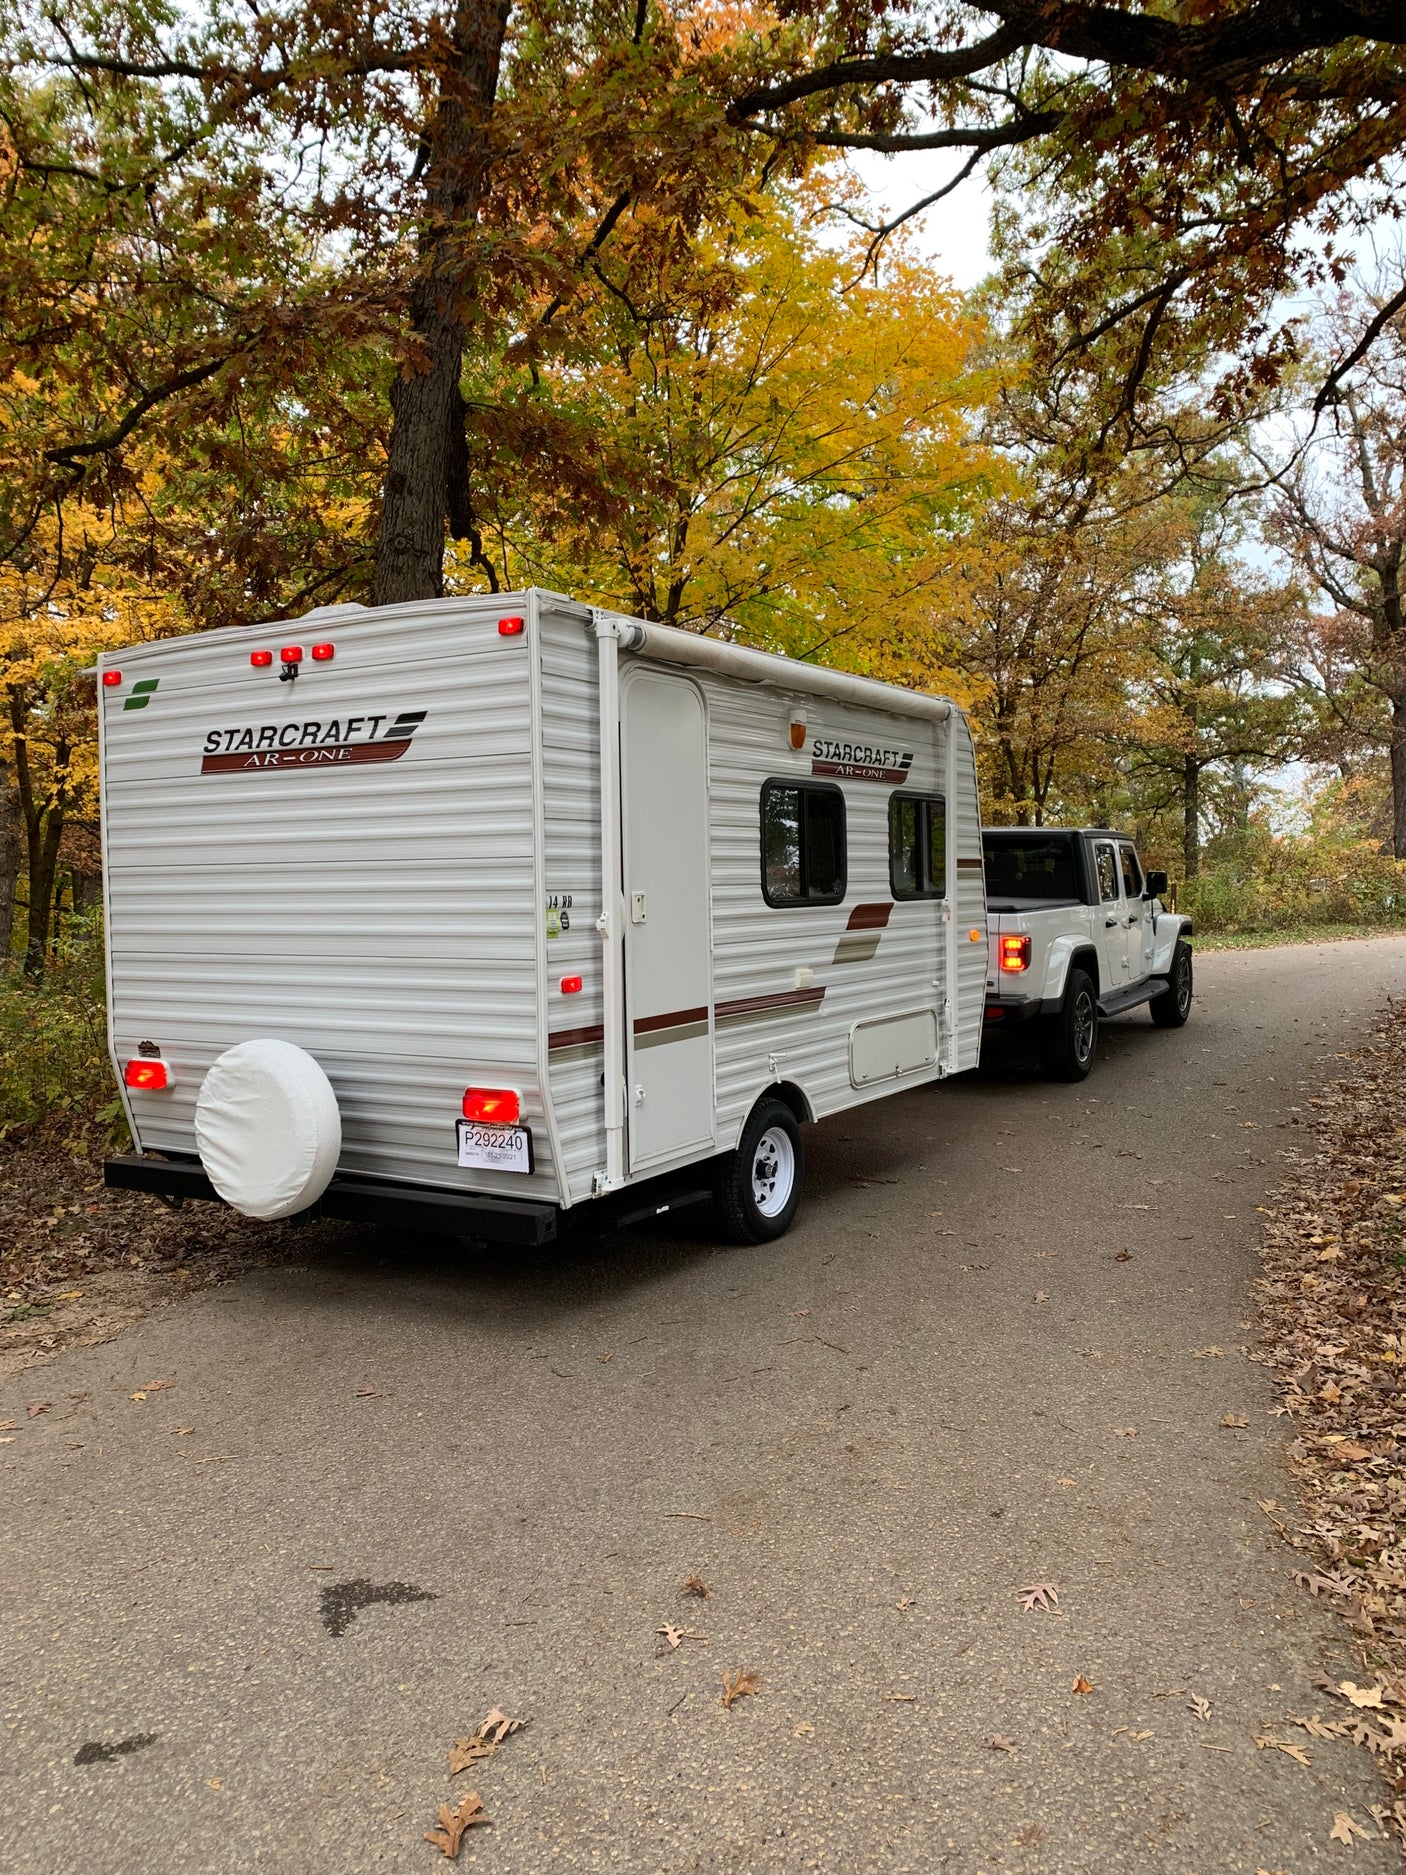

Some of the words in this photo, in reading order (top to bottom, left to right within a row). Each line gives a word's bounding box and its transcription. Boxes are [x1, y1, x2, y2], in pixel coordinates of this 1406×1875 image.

[203, 715, 387, 753] STARCRAFT
[243, 748, 353, 767] AR-ONE
[812, 740, 900, 767] STARCRAFT
[835, 765, 887, 779] AR-ONE
[465, 1131, 523, 1150] P292240
